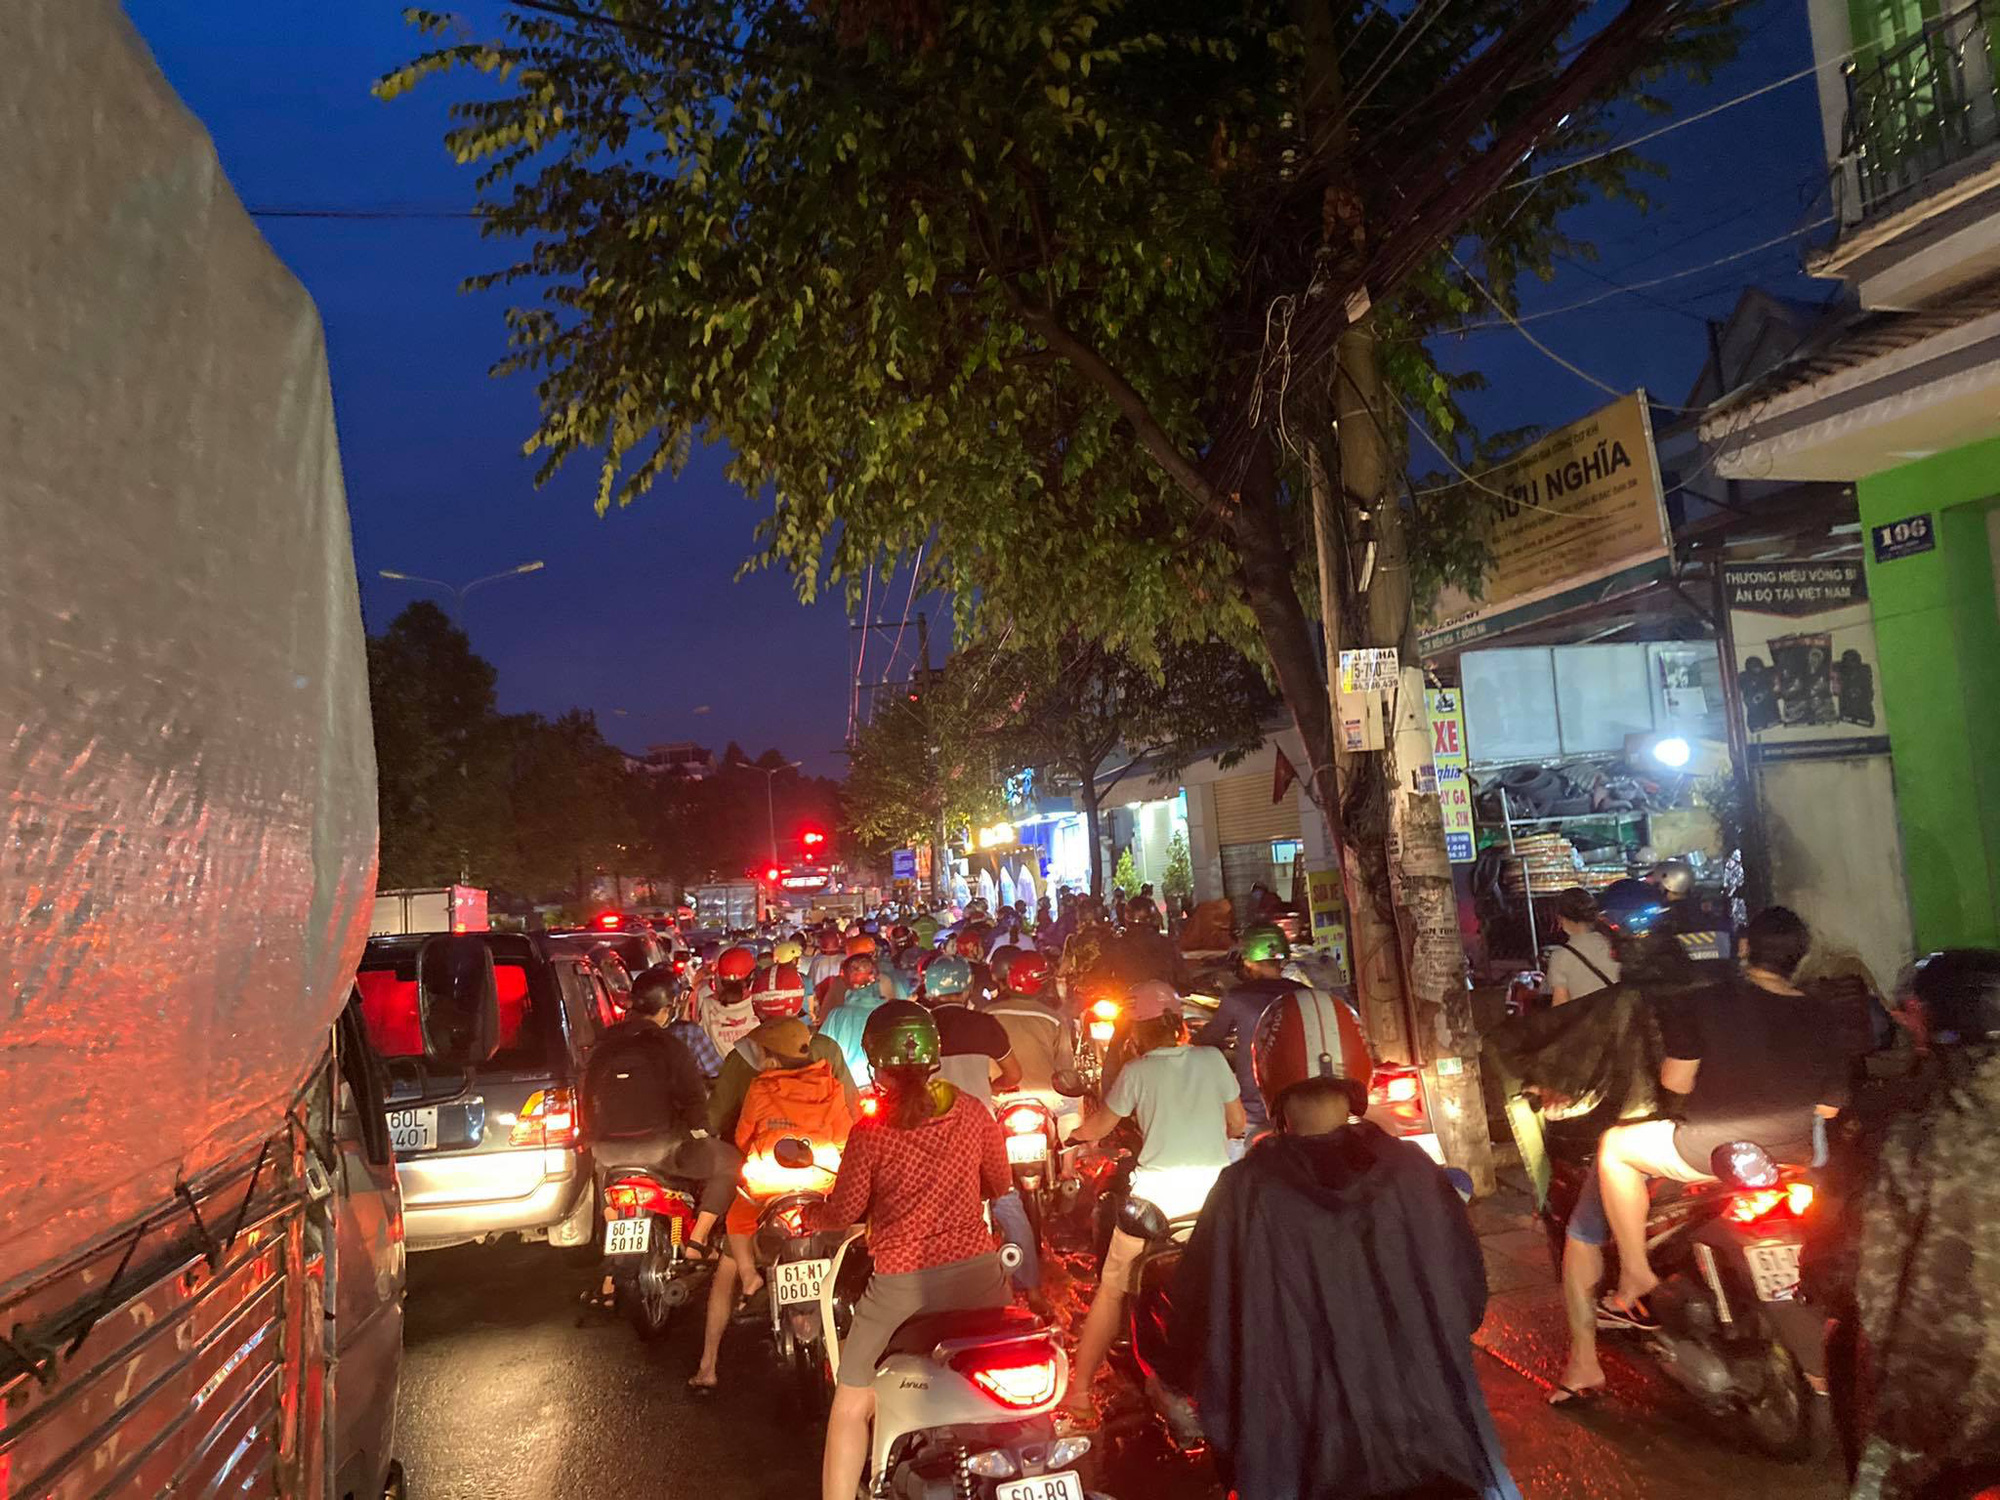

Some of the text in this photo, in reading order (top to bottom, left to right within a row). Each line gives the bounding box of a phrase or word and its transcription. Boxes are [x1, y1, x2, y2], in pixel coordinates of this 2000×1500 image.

[1545, 438, 1632, 501] NGHĨA
[1726, 570, 1776, 585] THƯƠNG
[1778, 569, 1807, 585] HIỆU
[1755, 587, 1773, 605] ĐỘ
[1775, 588, 1795, 603] TẠI
[1796, 586, 1823, 602] VIỆT
[1824, 586, 1852, 600] NAM
[1433, 720, 1460, 754] XE
[1452, 788, 1467, 806] GA
[390, 1109, 425, 1129] 60L
[394, 1128, 429, 1147] 401
[612, 1220, 645, 1237] 60-T5
[610, 1236, 644, 1252] 5018
[784, 1263, 824, 1284] 61-N1
[780, 1281, 821, 1301] 060.9
